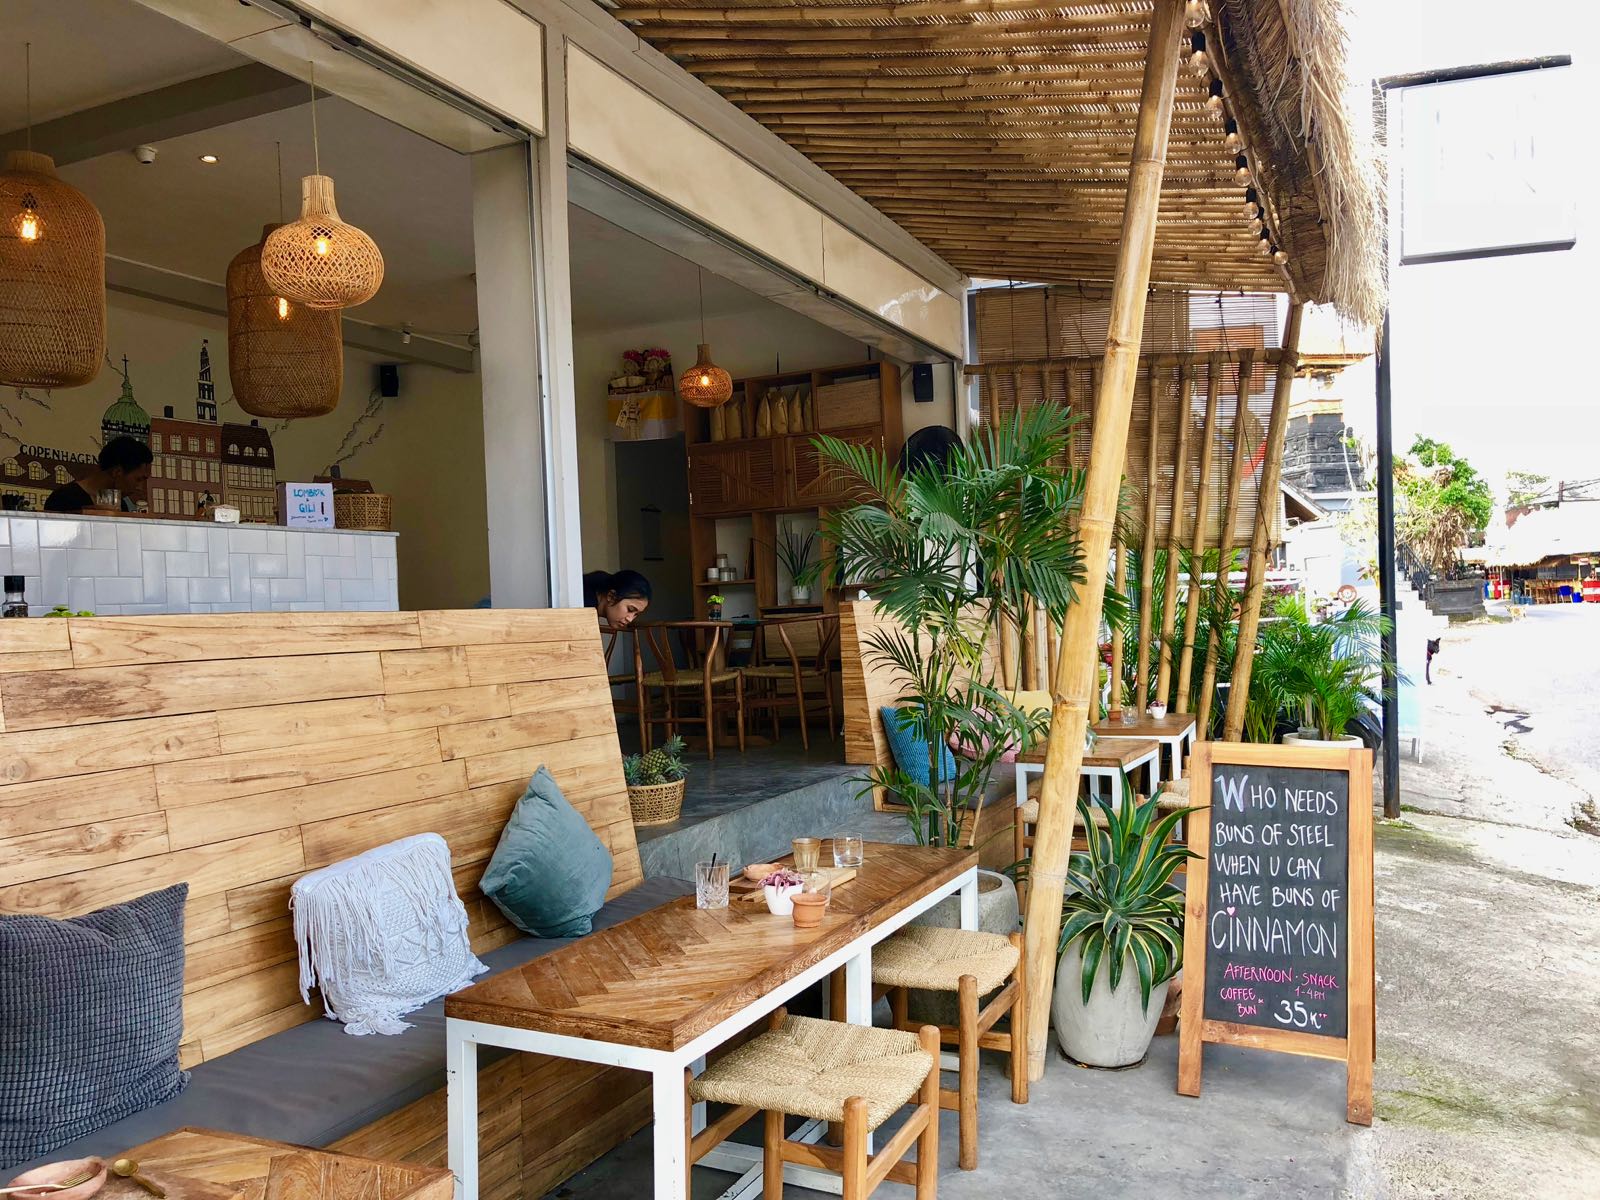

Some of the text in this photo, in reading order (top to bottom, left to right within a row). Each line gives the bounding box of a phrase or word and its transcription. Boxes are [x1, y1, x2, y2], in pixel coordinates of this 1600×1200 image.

[19, 444, 101, 465] COPENHAGEN
[298, 503, 316, 513] GILI
[1214, 774, 1338, 816] WHO NEEDS
[1214, 821, 1335, 847] BUNS OF STEEL
[1214, 852, 1322, 880] WHEN U CAN
[1219, 882, 1341, 912] HAVE BUNS OF
[1211, 908, 1337, 959] CINNAMON
[1223, 962, 1340, 989] AFTERNOON SNACK
[1219, 987, 1256, 1000] COFFEE
[1236, 1002, 1257, 1018] BUN
